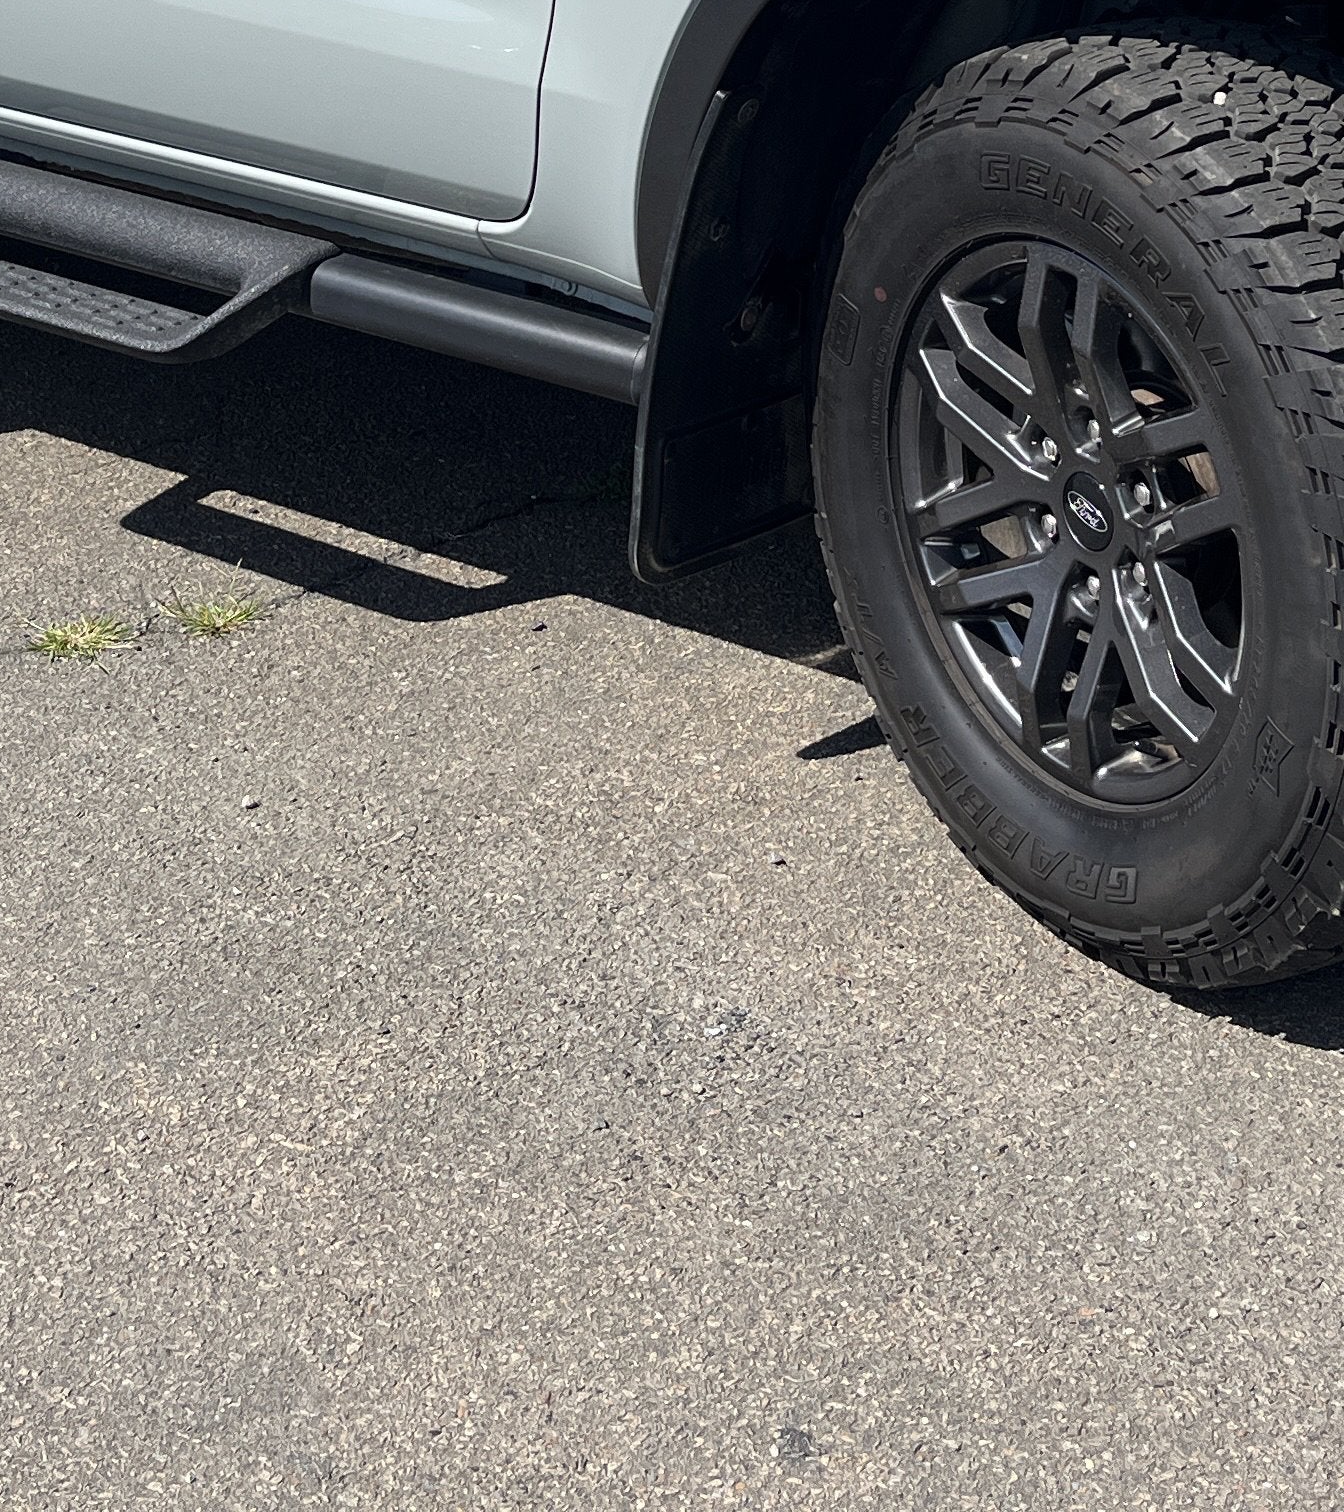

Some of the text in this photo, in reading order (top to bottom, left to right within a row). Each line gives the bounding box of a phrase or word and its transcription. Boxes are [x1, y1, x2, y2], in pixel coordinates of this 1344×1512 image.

[980, 150, 1231, 398] GENERAL
[1071, 497, 1100, 527] Ford
[901, 704, 1138, 905] GRABBER
